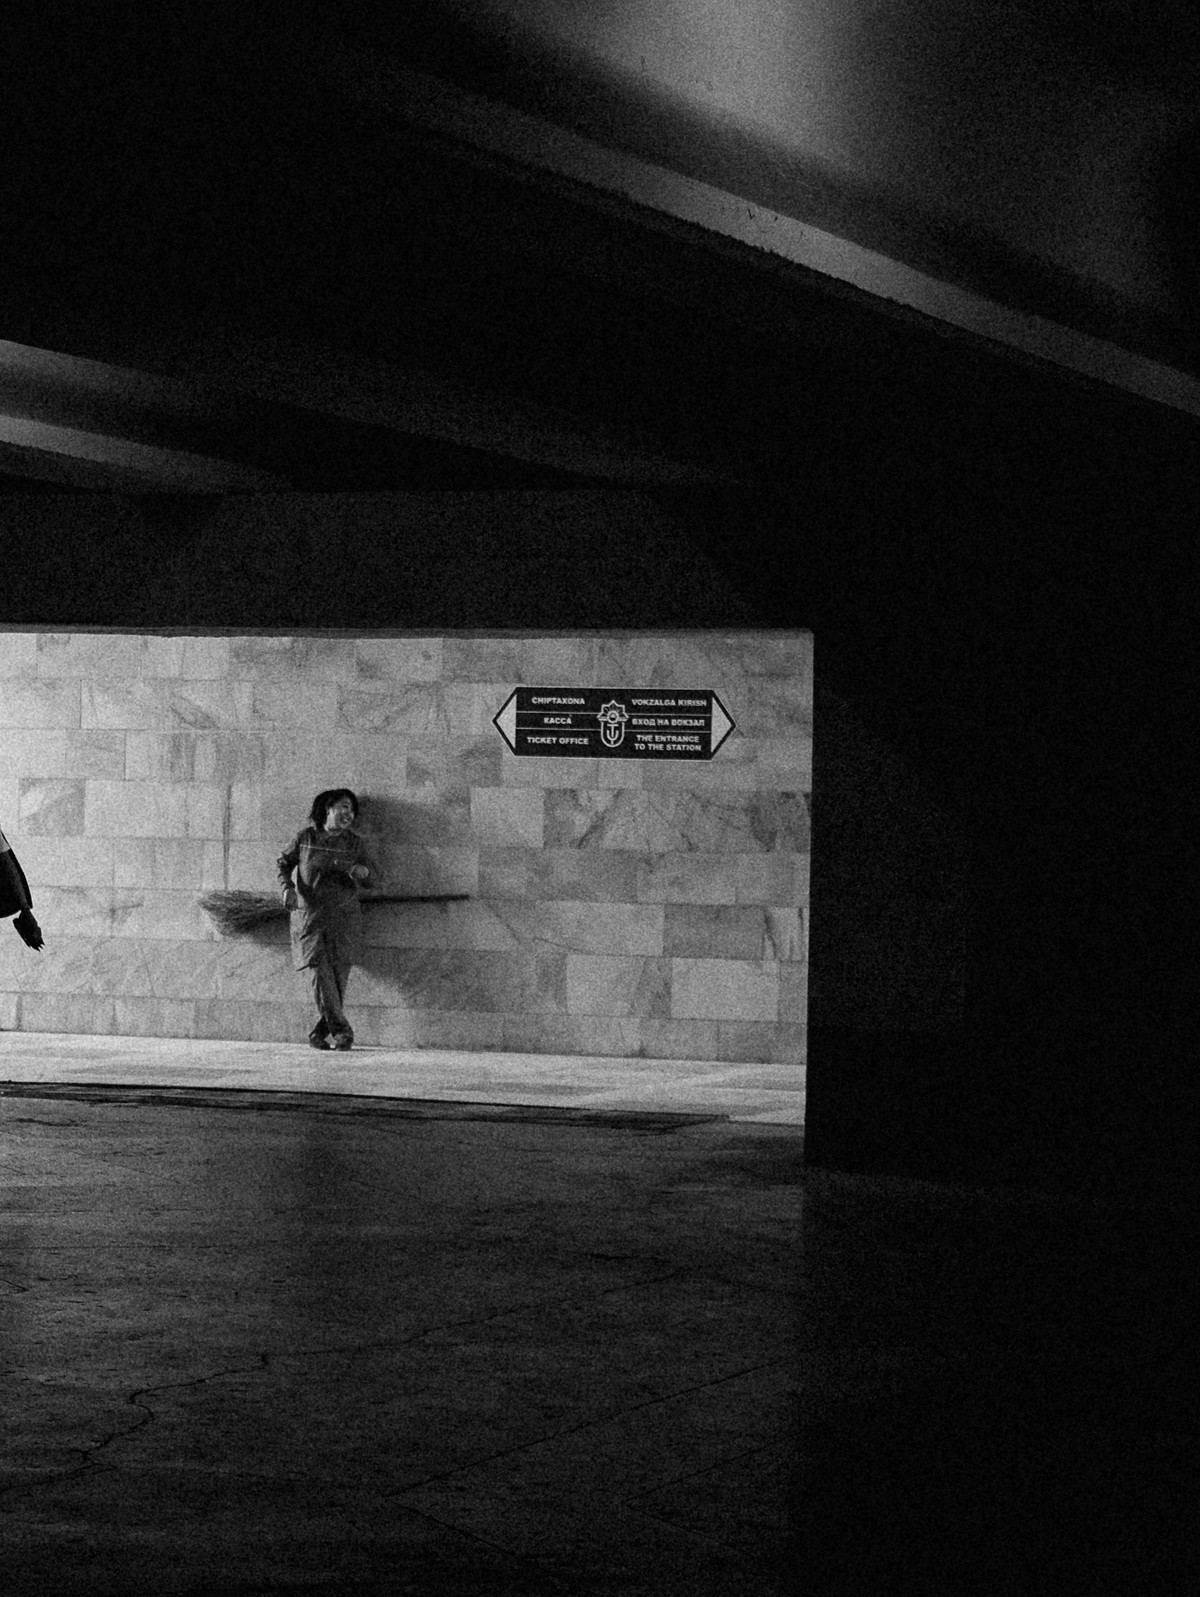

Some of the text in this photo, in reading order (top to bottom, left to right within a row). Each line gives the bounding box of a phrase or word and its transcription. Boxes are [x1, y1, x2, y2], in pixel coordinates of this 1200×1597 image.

[678, 699, 707, 707] KIRISH
[632, 718, 656, 726] ВХОД
[657, 718, 669, 726] НА
[527, 736, 589, 745] TICKET OFFICE
[655, 735, 700, 743] ENTRANCE
[634, 743, 645, 751] TO
[666, 744, 701, 752] STATION
